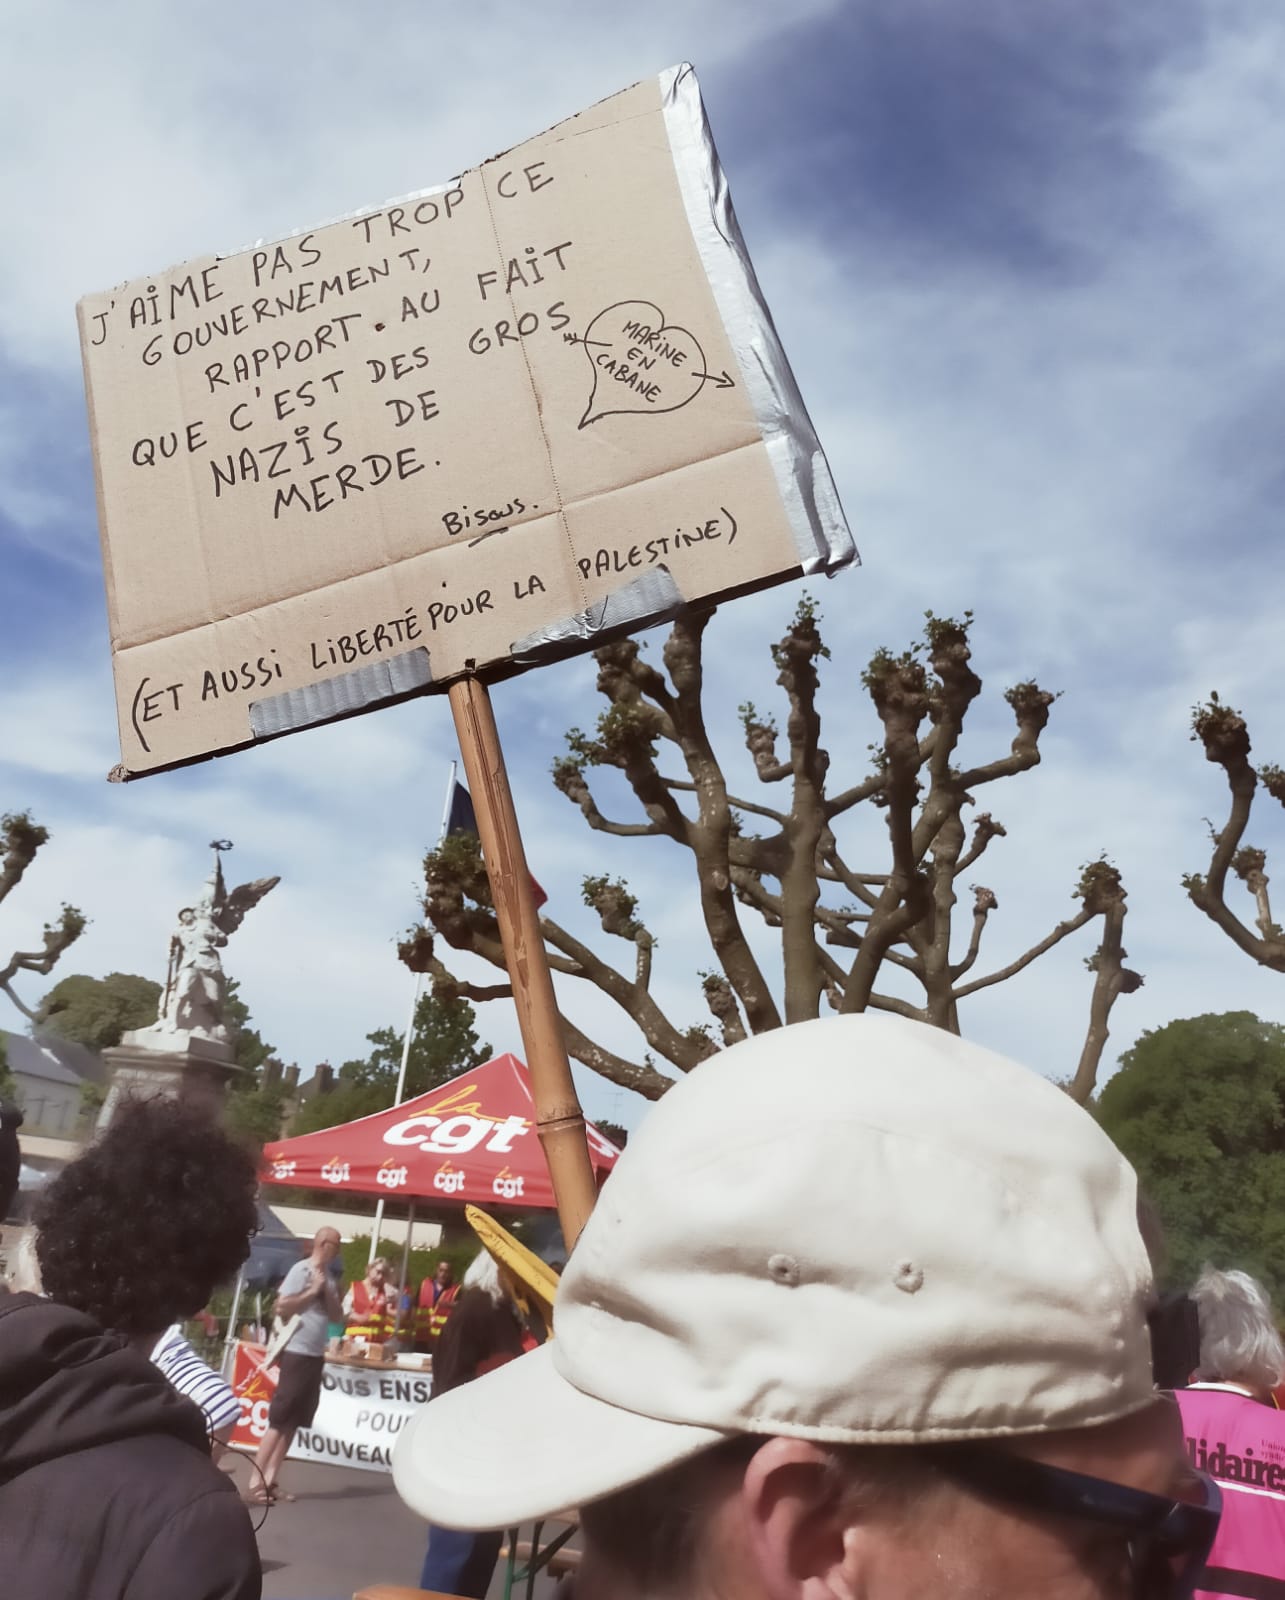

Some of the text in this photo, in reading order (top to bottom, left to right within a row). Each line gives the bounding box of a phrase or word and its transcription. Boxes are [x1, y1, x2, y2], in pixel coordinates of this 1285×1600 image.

[252, 235, 321, 287] PAS
[352, 189, 465, 243] TROP
[497, 162, 554, 198] CE
[142, 248, 431, 366] GOUVERNEMENT,
[401, 289, 441, 322] AU
[627, 347, 657, 370] EN
[132, 301, 570, 466] QUE C'EST DES GROS
[596, 354, 662, 403] CABANE
[385, 390, 440, 427] DE
[274, 448, 441, 519] MERDE.
[132, 677, 184, 752] (ET
[427, 590, 494, 630] POUR
[514, 575, 546, 599] LA
[383, 1115, 529, 1154] cgt
[376, 1166, 408, 1189] cgt
[433, 1170, 465, 1193] cgt
[493, 1176, 524, 1198] cgt
[379, 1379, 433, 1404] ENS
